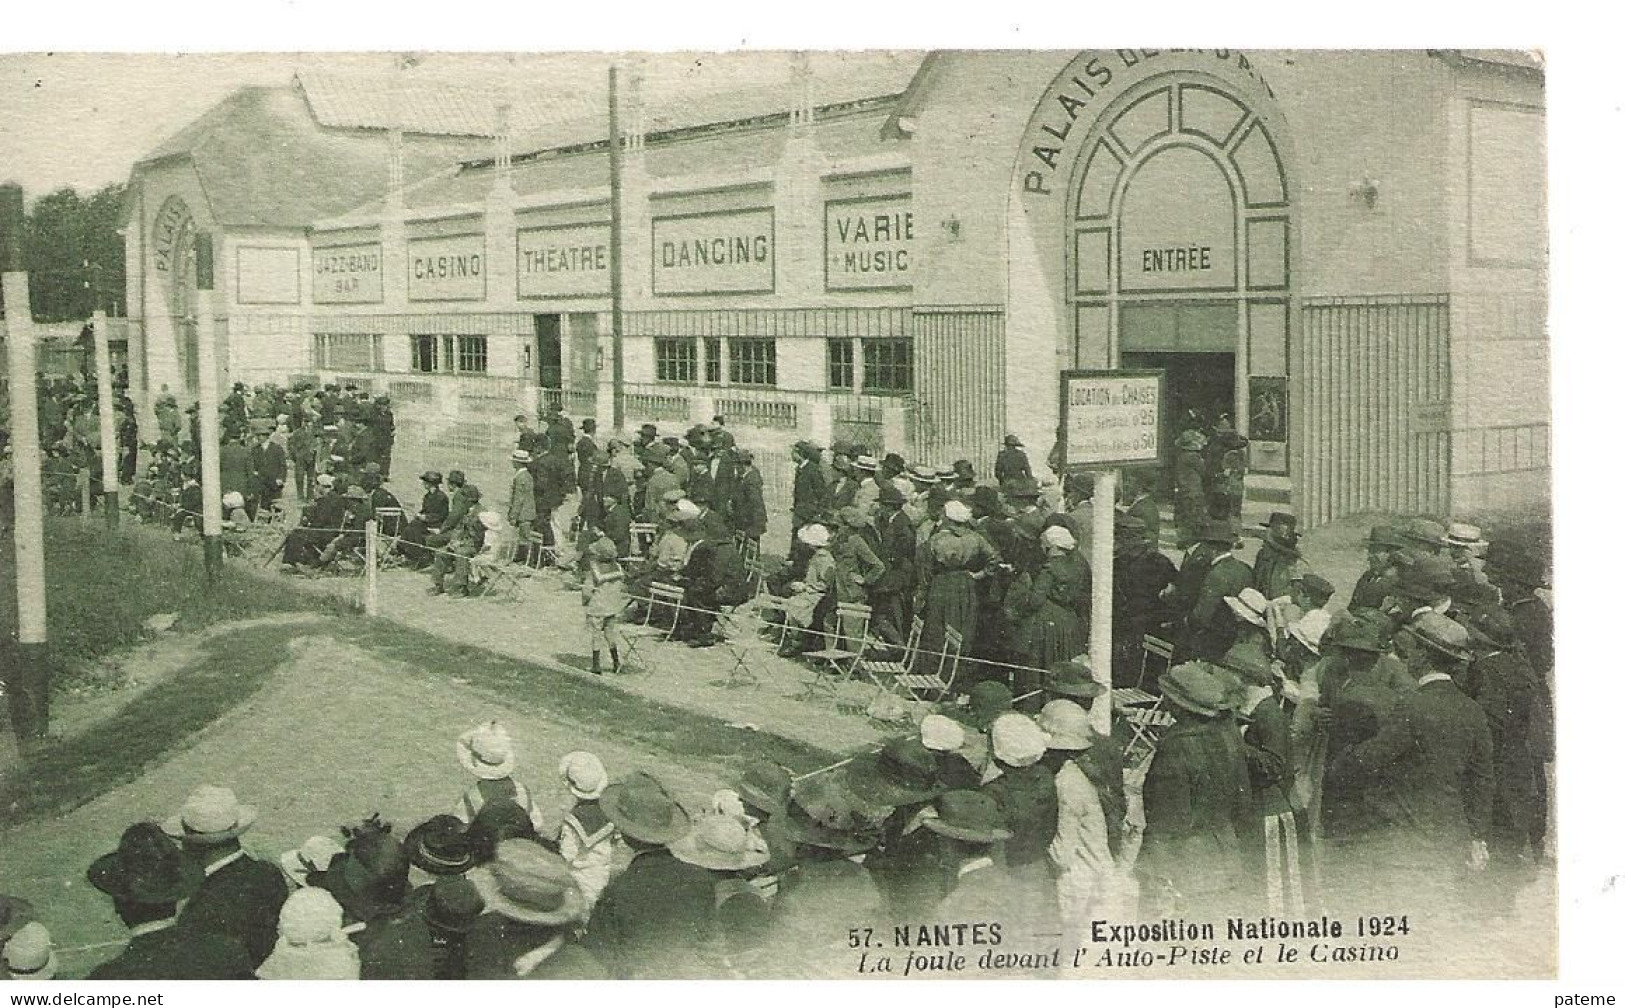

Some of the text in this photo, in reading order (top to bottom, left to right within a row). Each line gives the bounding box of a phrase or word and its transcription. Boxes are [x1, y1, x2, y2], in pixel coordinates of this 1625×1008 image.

[1024, 57, 1112, 195] PALAIS
[316, 254, 378, 274] JAZZ-BAND
[662, 235, 767, 267] DANCING
[1142, 243, 1211, 272] ENTRÉE
[414, 254, 480, 279] CASINO
[335, 278, 359, 293] BAR
